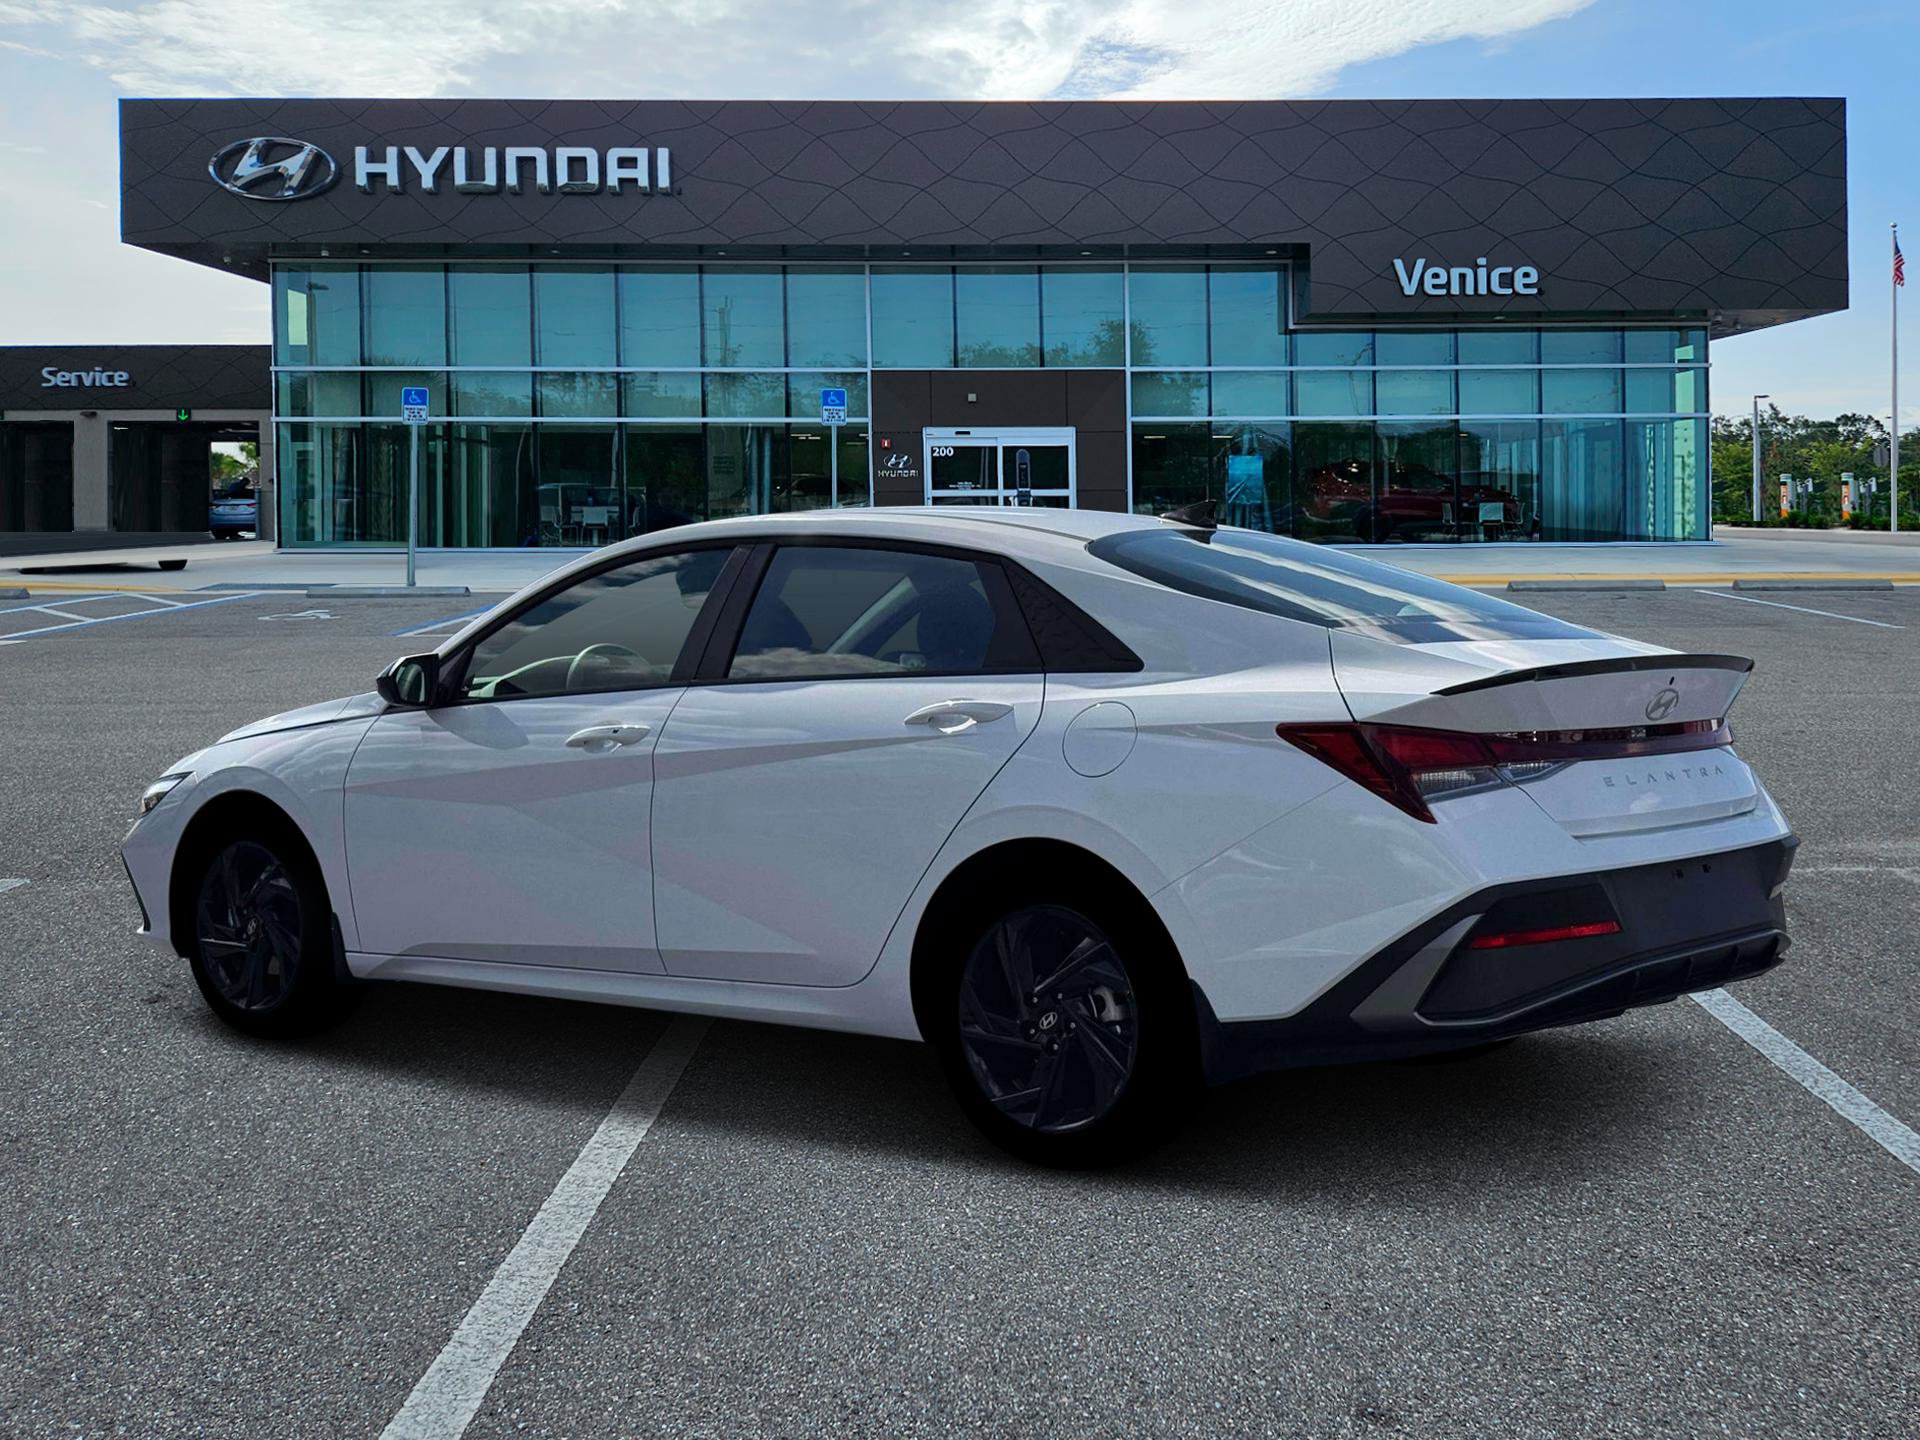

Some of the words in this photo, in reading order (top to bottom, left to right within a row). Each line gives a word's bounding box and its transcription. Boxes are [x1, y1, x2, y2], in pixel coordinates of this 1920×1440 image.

[354, 145, 670, 193] HYUNDAI
[1393, 256, 1538, 296] Venice
[41, 366, 129, 387] Service
[932, 447, 954, 457] 200
[1603, 765, 1724, 788] ELANTRA
